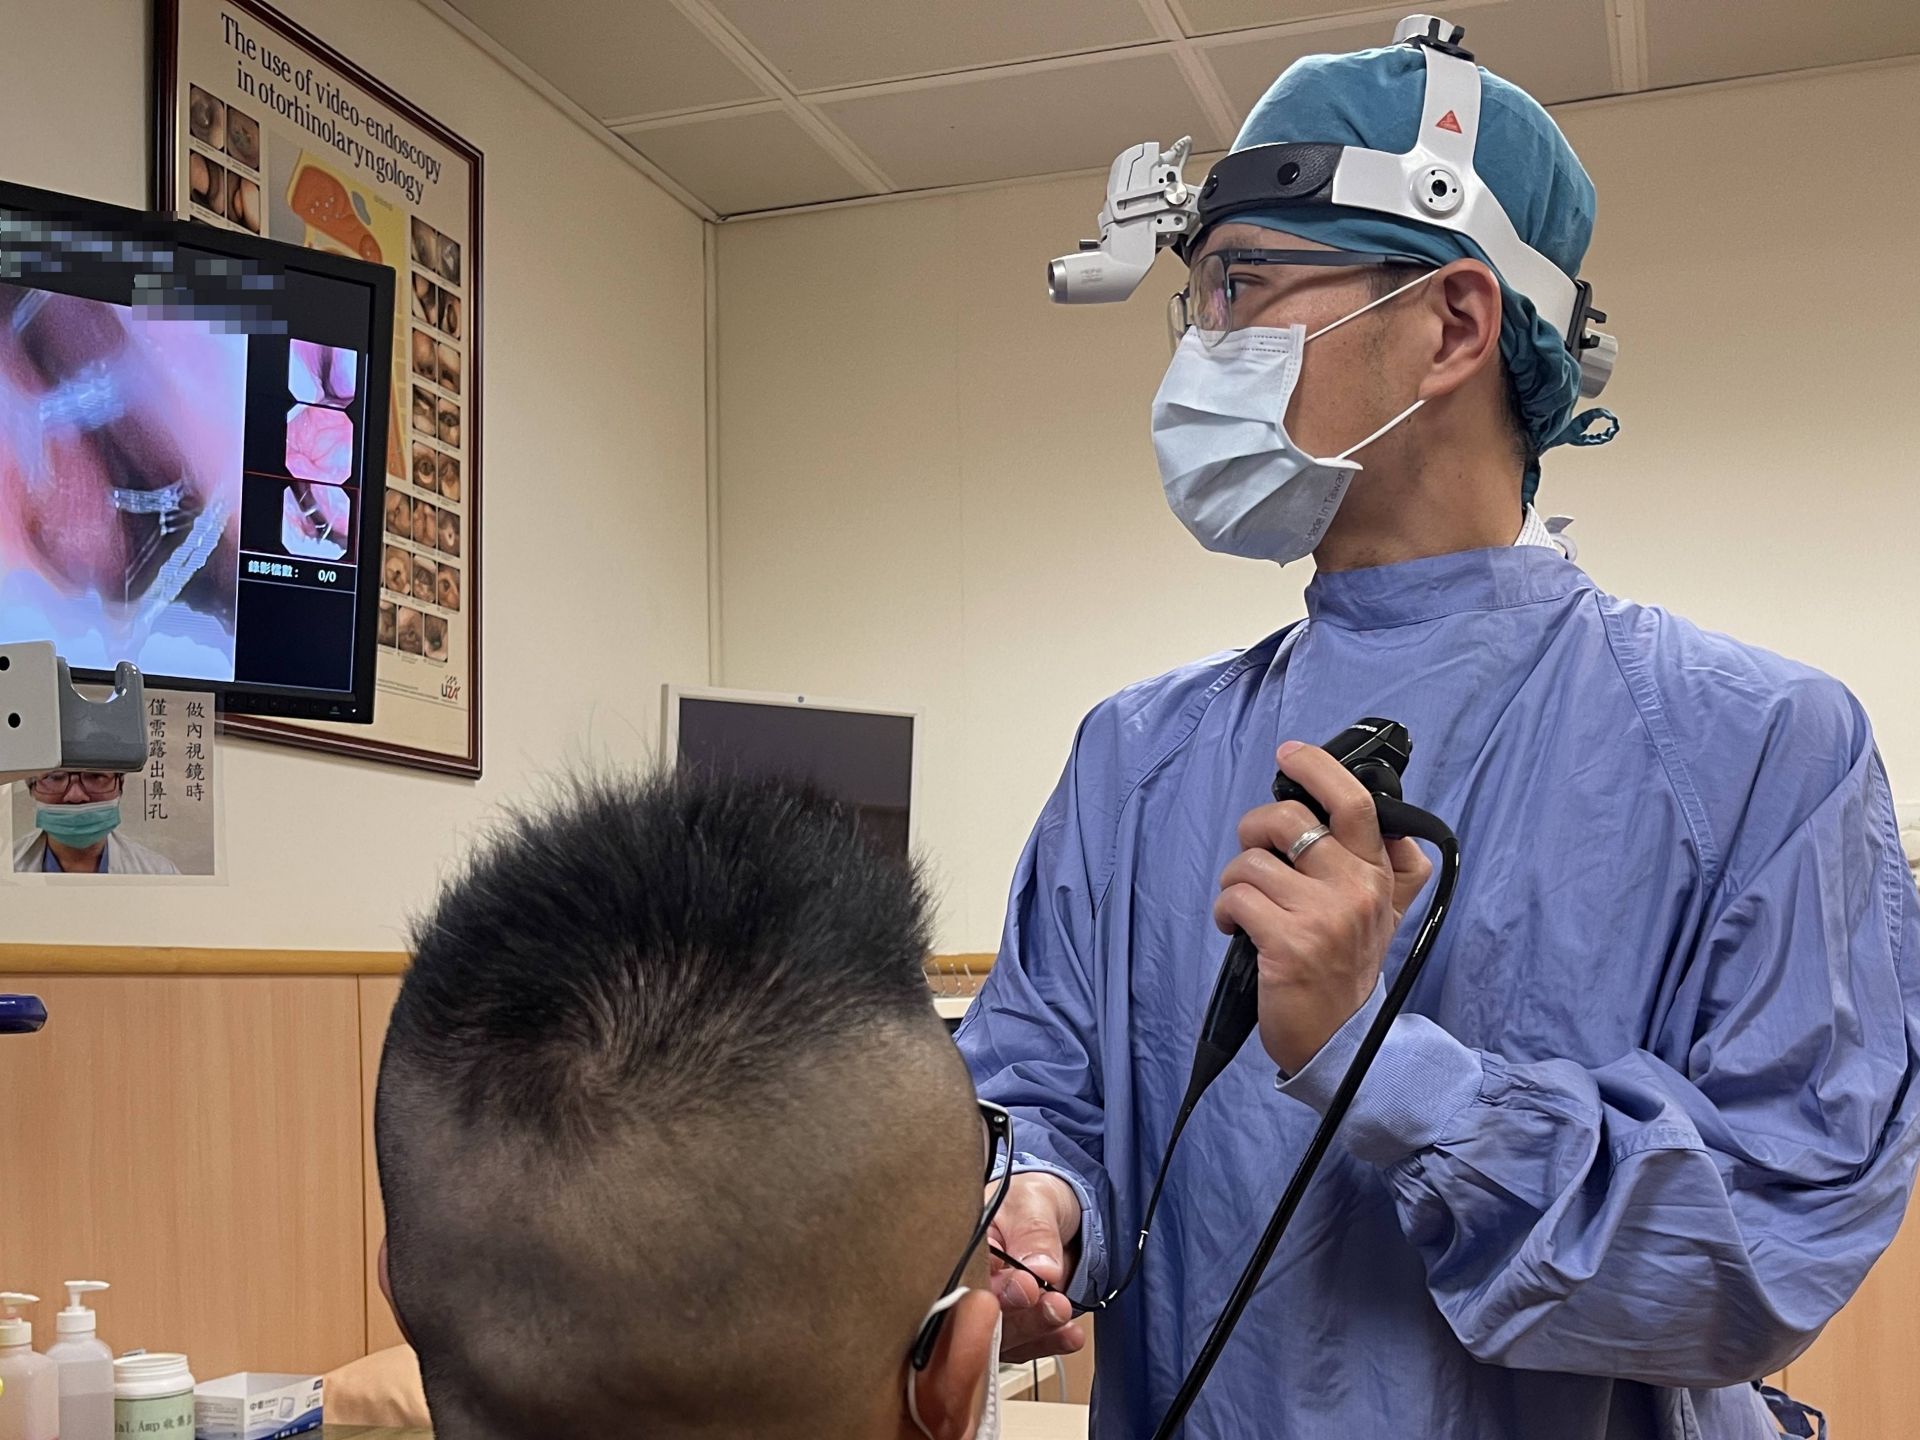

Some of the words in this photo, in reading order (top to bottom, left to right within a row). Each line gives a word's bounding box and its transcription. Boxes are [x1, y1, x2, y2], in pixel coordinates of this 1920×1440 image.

[221, 12, 256, 60] The
[261, 47, 291, 83] use
[295, 69, 313, 96] of
[315, 82, 441, 184] video-endoscopy
[237, 60, 255, 96] in
[258, 82, 424, 205] otorhinolaryngology
[318, 569, 337, 583] 0/0
[148, 698, 168, 820] 僅需露出鼻孔
